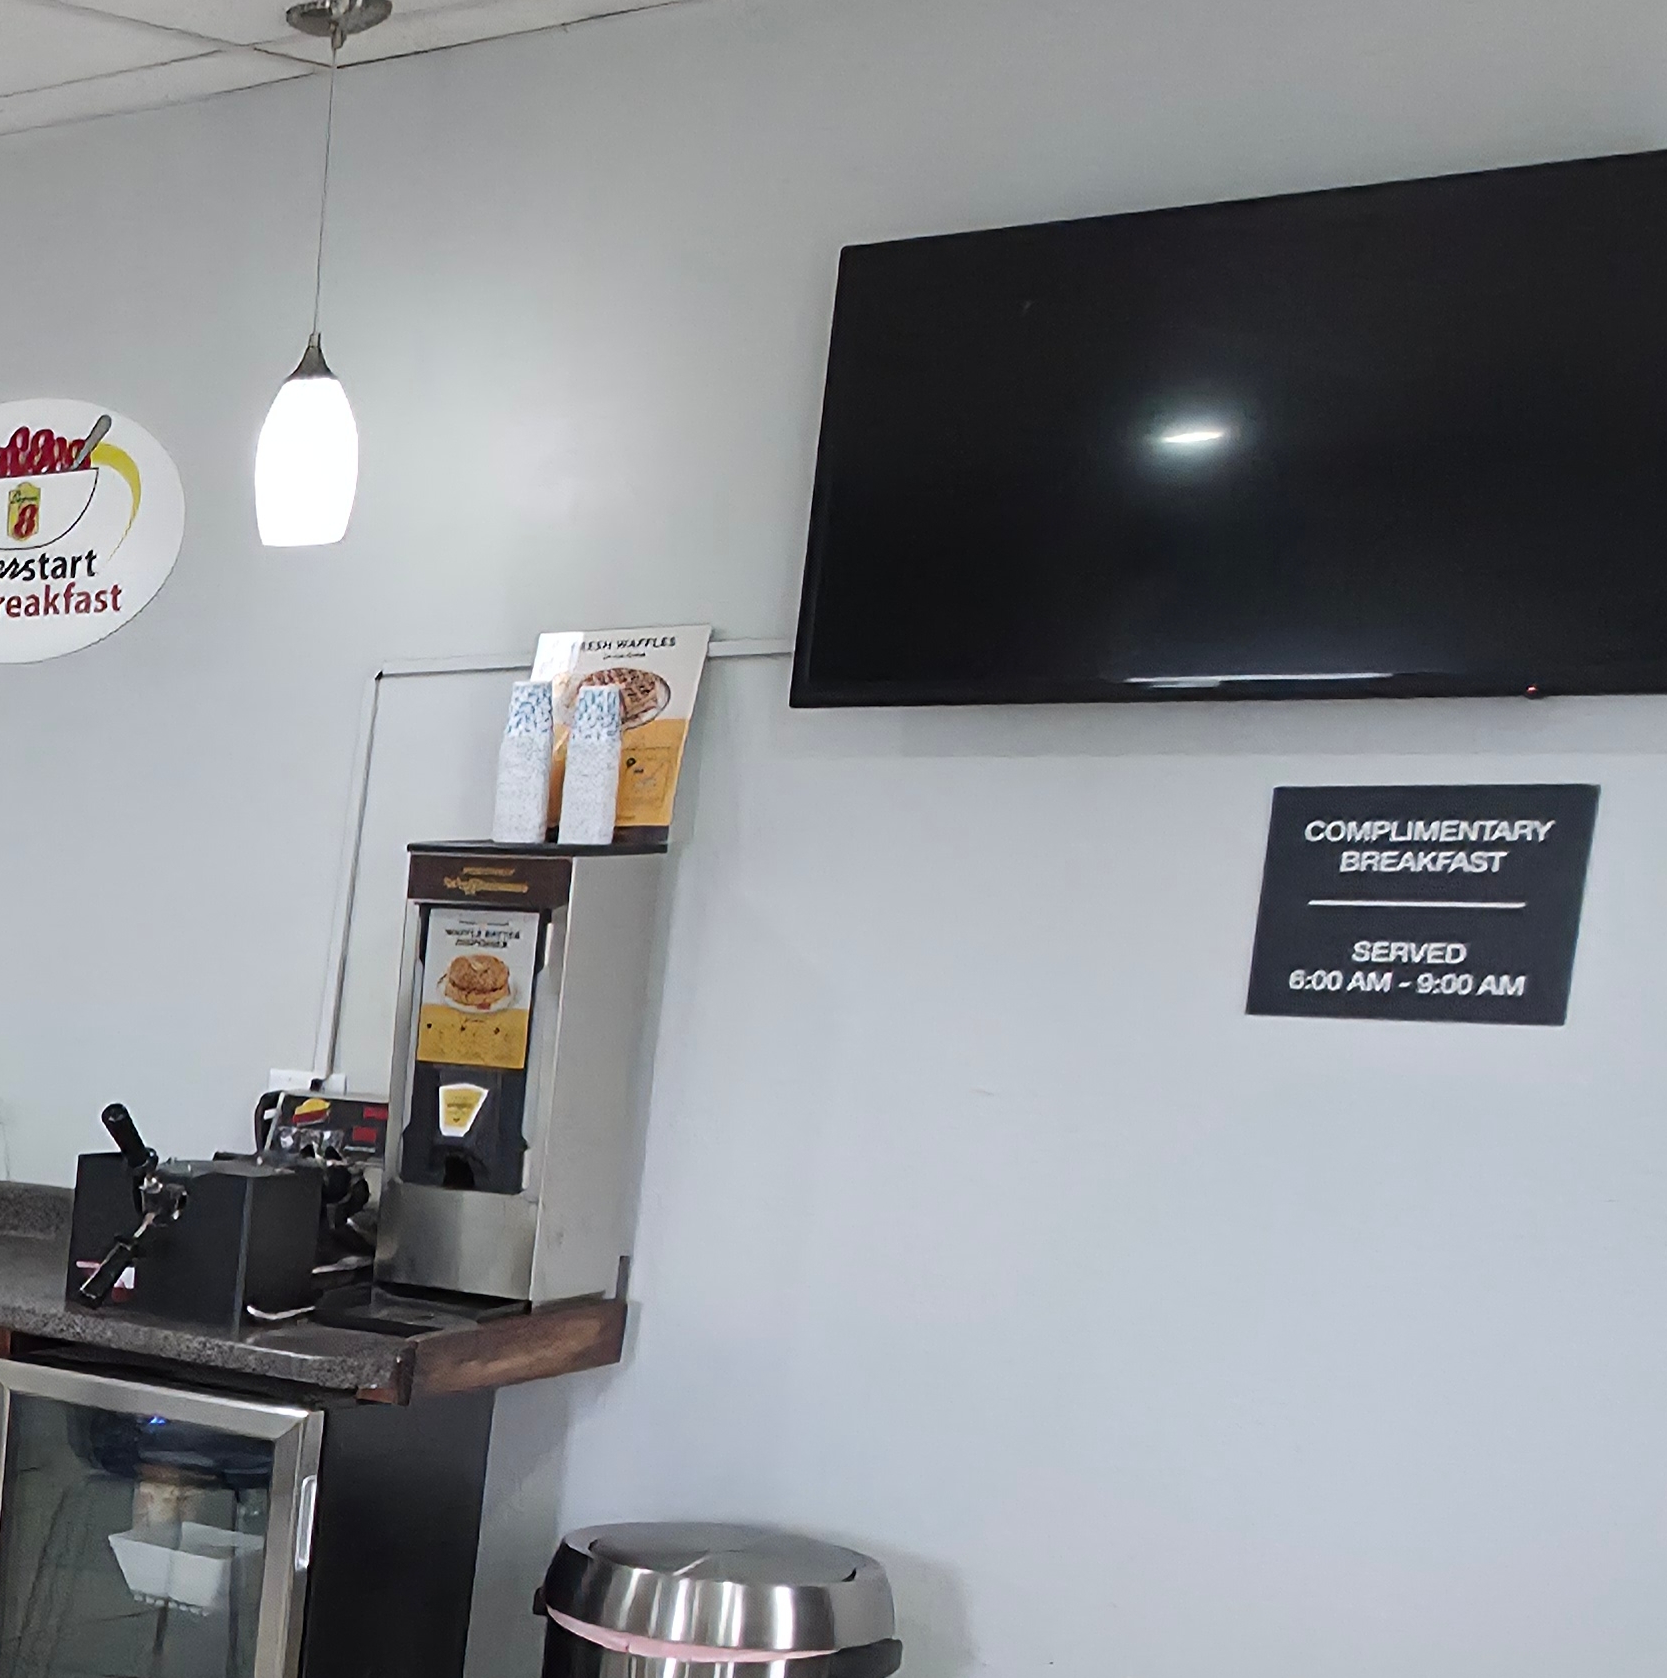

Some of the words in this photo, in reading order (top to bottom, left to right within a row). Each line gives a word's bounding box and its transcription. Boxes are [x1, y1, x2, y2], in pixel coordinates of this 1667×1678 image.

[570, 639, 613, 652] RESH
[1303, 820, 1556, 843] COMPLIMENTARY
[1338, 851, 1509, 874] BREAKFAST
[1351, 940, 1468, 964] SERVED
[1288, 969, 1343, 992] 6:00
[1346, 971, 1393, 993] AM
[1416, 972, 1474, 995] 9:00
[1476, 974, 1527, 997] AM
